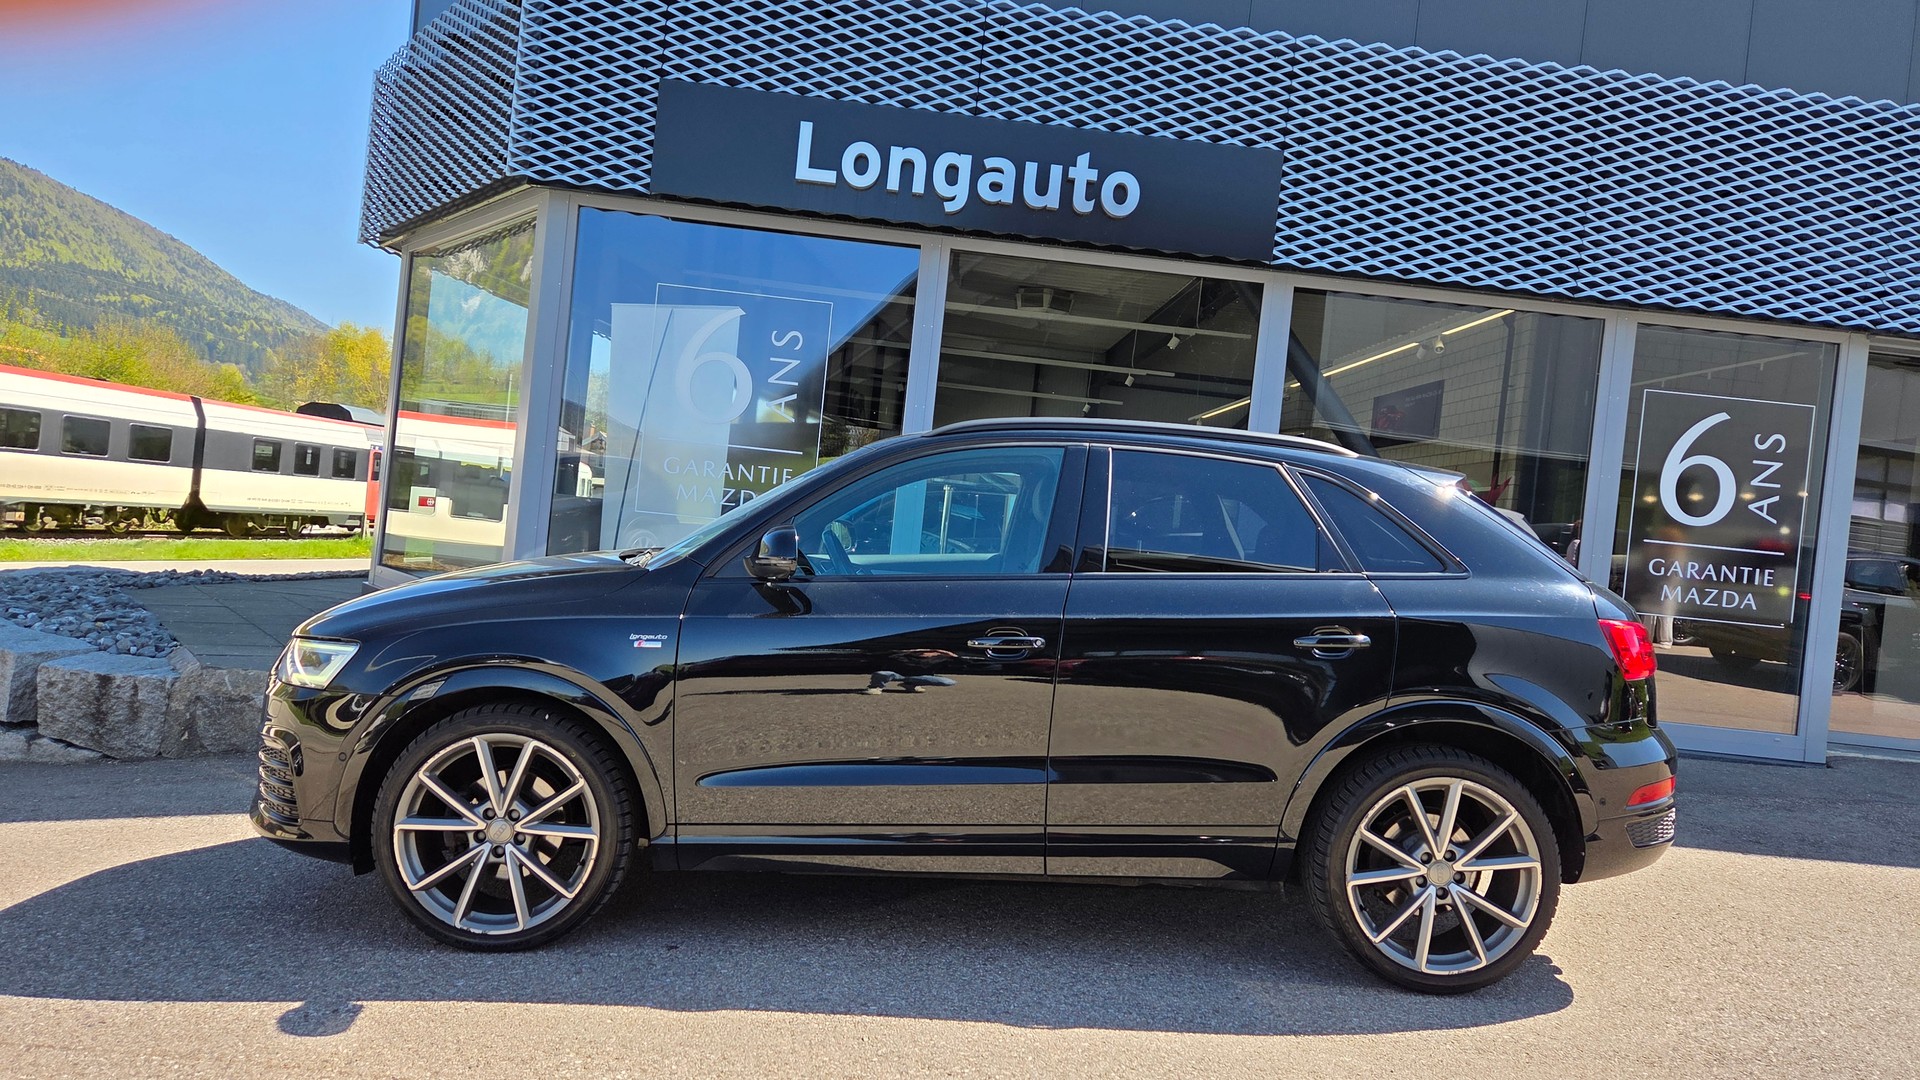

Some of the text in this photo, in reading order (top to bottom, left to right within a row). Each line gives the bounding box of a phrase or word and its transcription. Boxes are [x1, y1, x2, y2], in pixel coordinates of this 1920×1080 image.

[794, 120, 1142, 219] Longauto
[674, 306, 753, 425] 6
[765, 329, 804, 424] ANS
[663, 456, 794, 485] GARANTIE
[676, 483, 758, 507] MAZD
[1659, 411, 1737, 527] 6
[1747, 432, 1787, 525] ANS
[1648, 558, 1775, 587] GARANTIE
[1660, 584, 1757, 611] MAZDA
